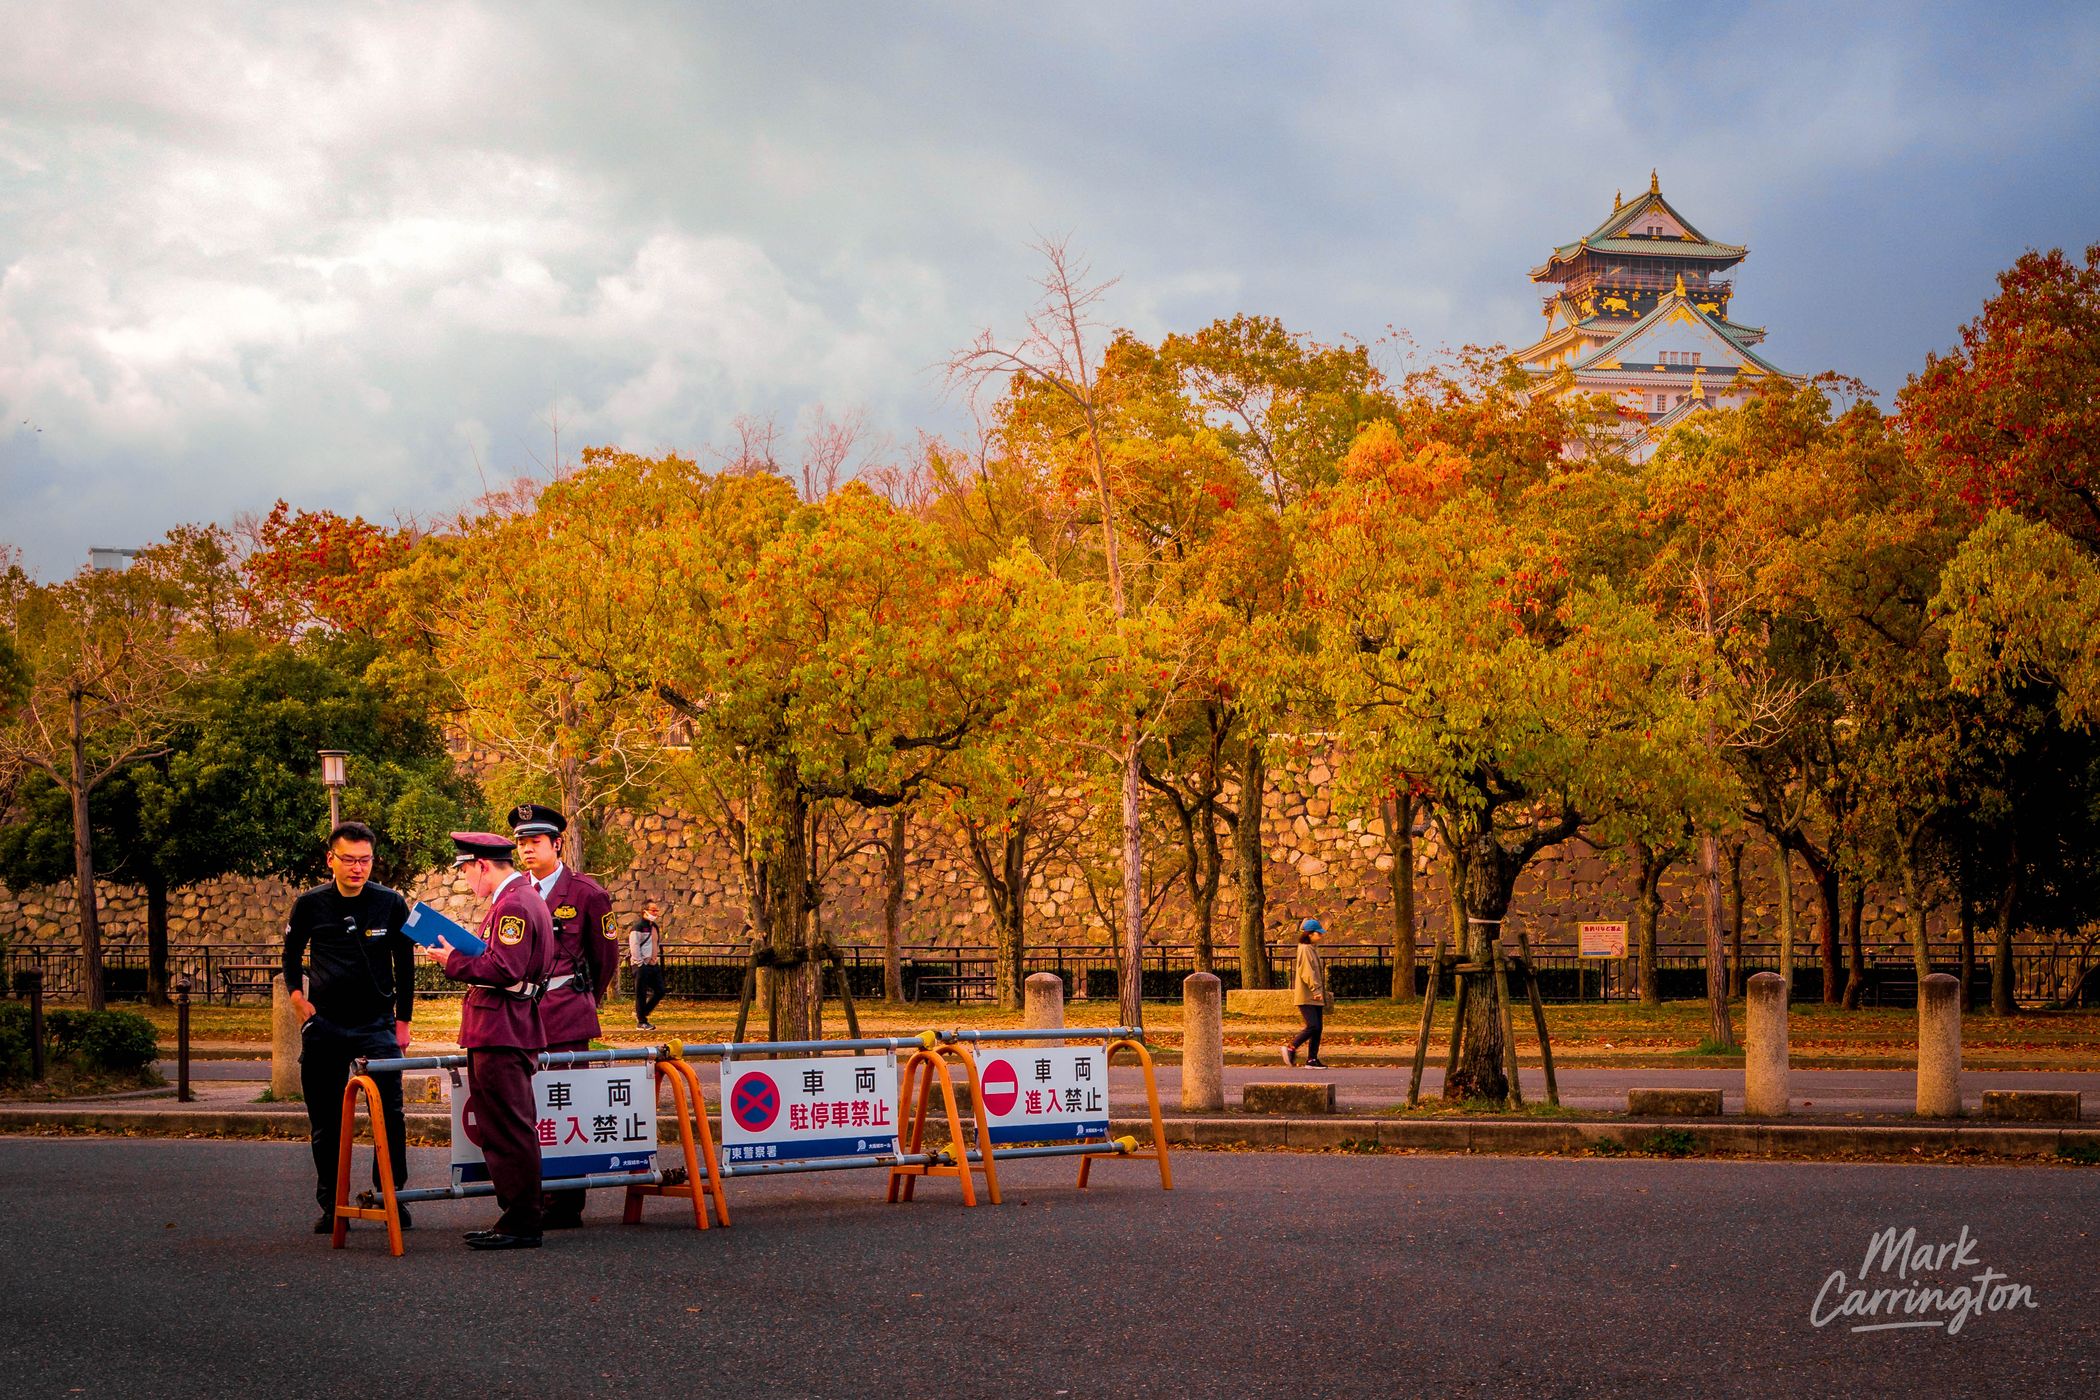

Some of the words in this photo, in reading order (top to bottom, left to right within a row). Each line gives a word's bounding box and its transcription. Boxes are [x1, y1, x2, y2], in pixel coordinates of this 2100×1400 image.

[790, 1099, 890, 1131] 駐停車禁止
[1025, 1087, 1102, 1114] 進入禁止
[536, 1113, 648, 1147] 進入禁止
[731, 1145, 777, 1159] 東警察署
